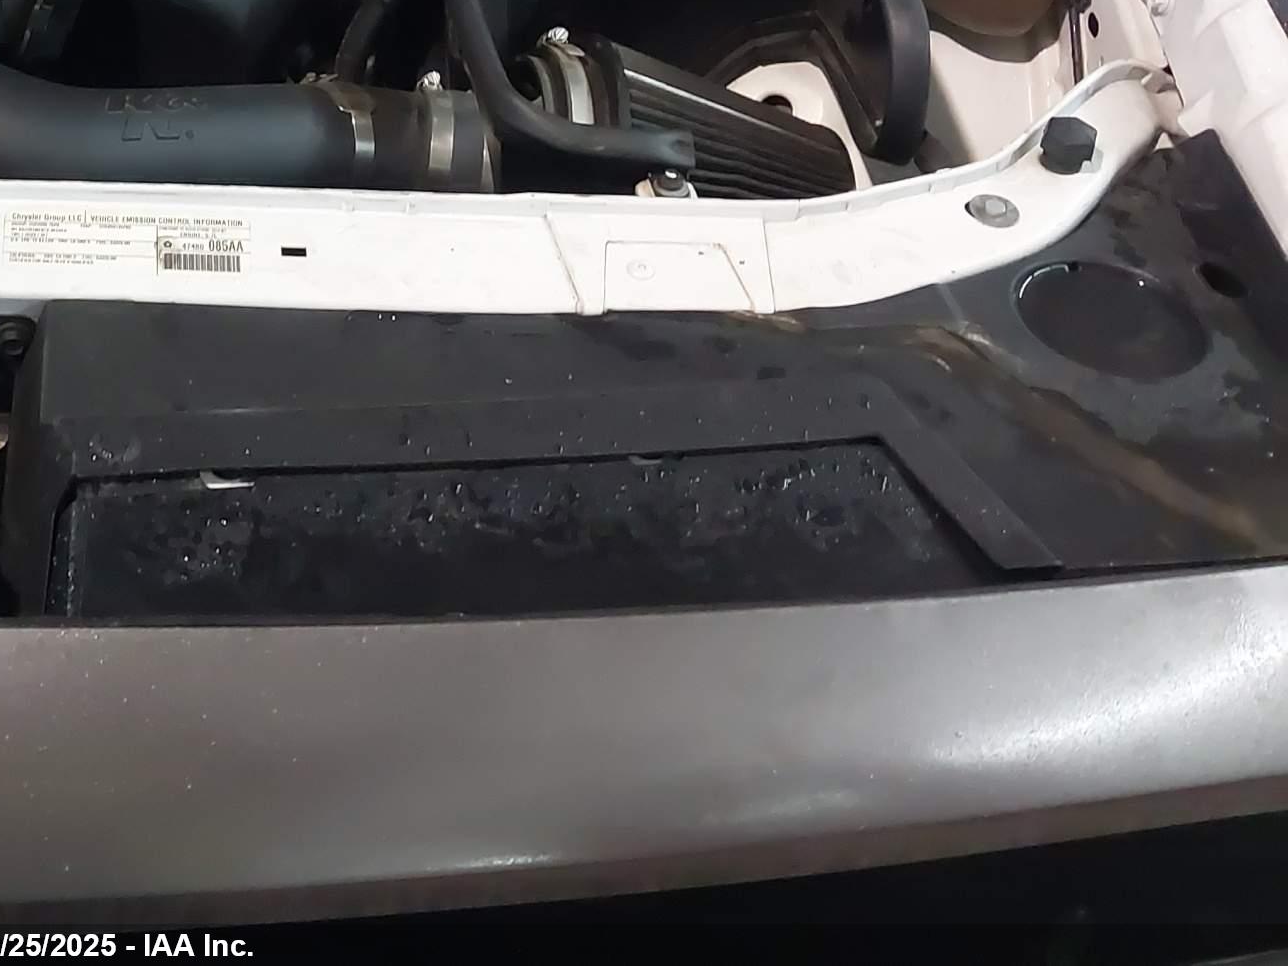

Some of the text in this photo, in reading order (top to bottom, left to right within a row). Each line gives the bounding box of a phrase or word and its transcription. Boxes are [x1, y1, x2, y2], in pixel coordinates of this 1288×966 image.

[11, 211, 42, 224] Chrysler
[44, 212, 66, 223] Group
[68, 213, 82, 222] LLC
[90, 215, 243, 227] VEHICLE EMISSION CONTROL INFORMATION
